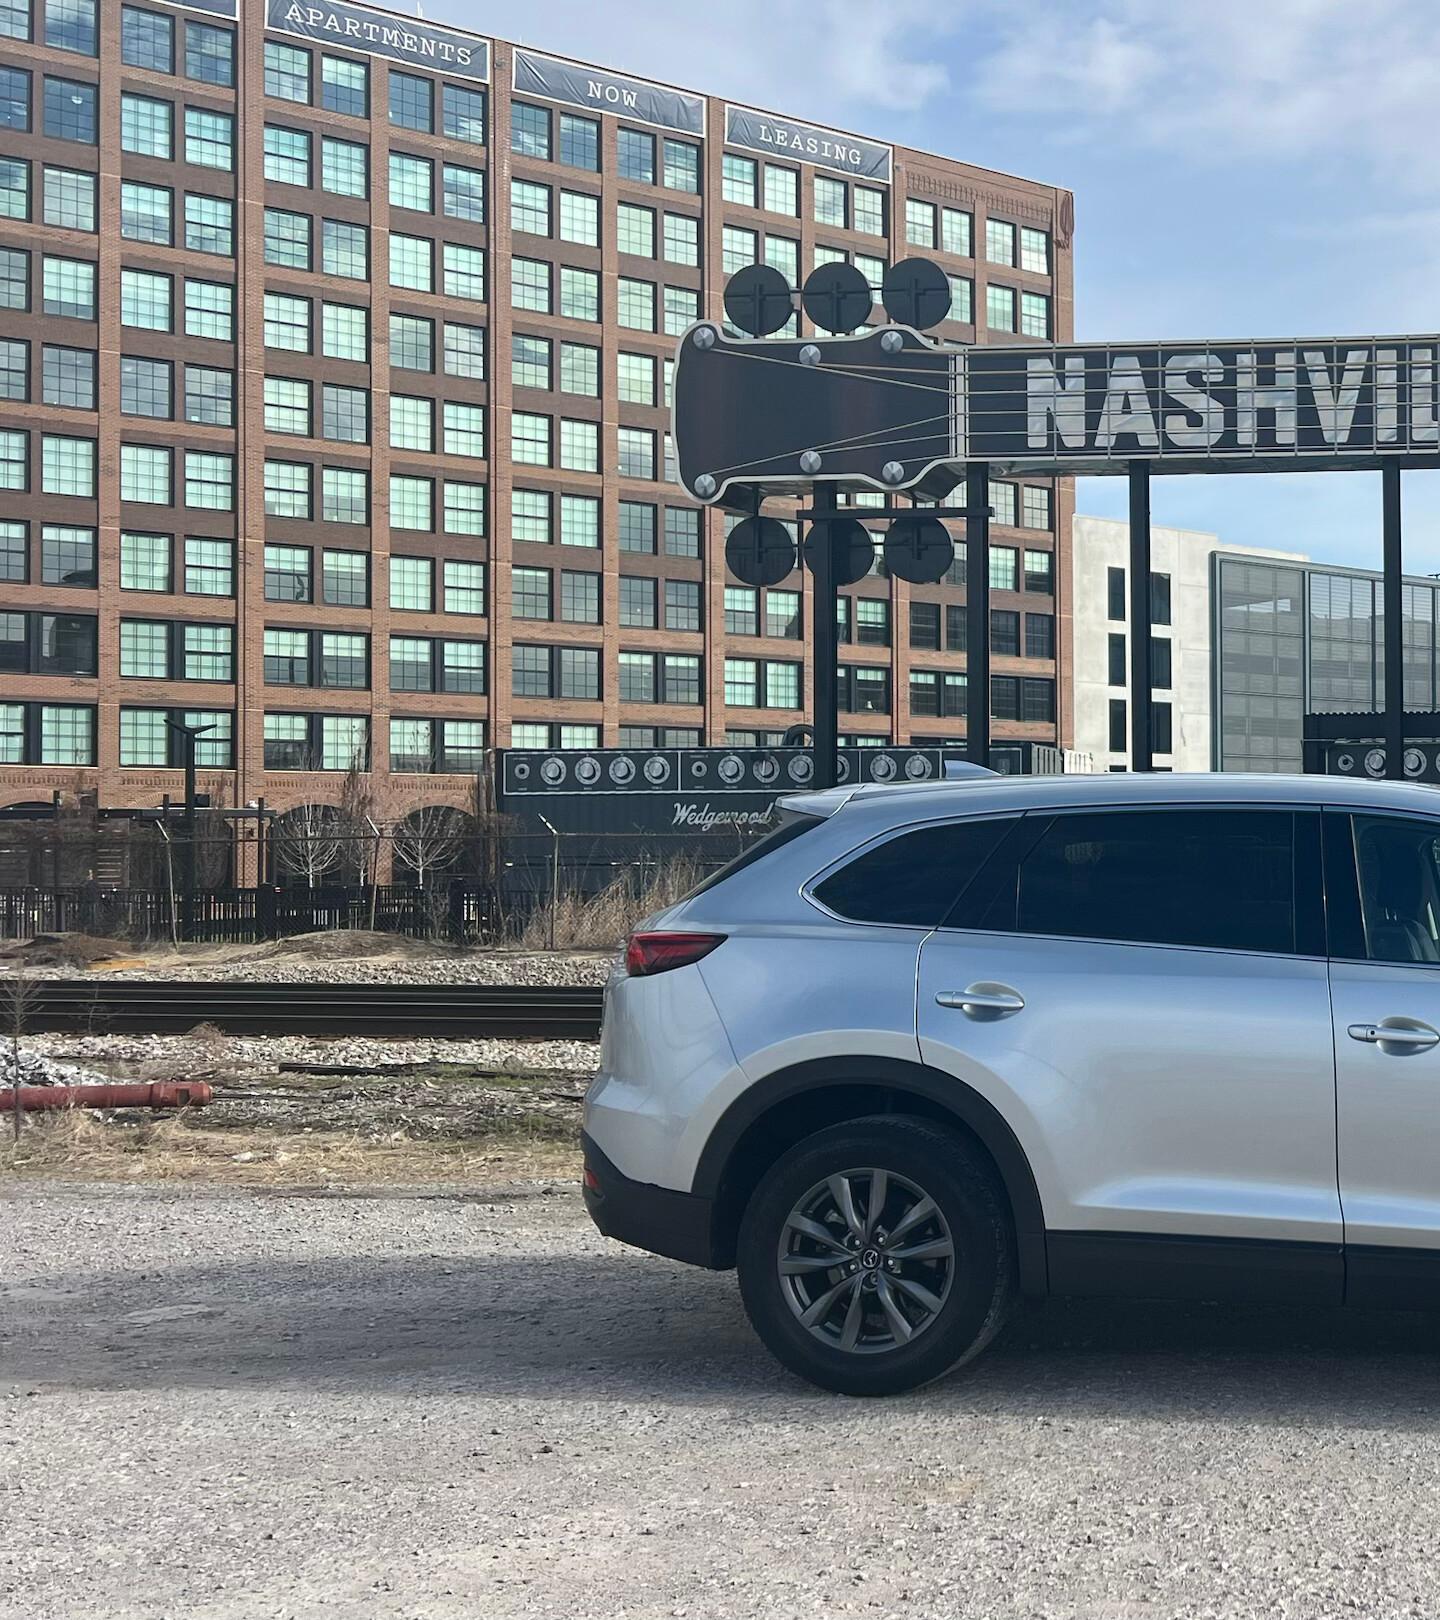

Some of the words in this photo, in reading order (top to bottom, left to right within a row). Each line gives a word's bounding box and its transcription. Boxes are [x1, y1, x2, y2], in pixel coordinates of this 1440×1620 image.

[284, 4, 472, 66] APARTMENTS
[587, 80, 638, 108] NOW
[759, 125, 862, 165] LEASING
[672, 802, 775, 832] Wedgewood
